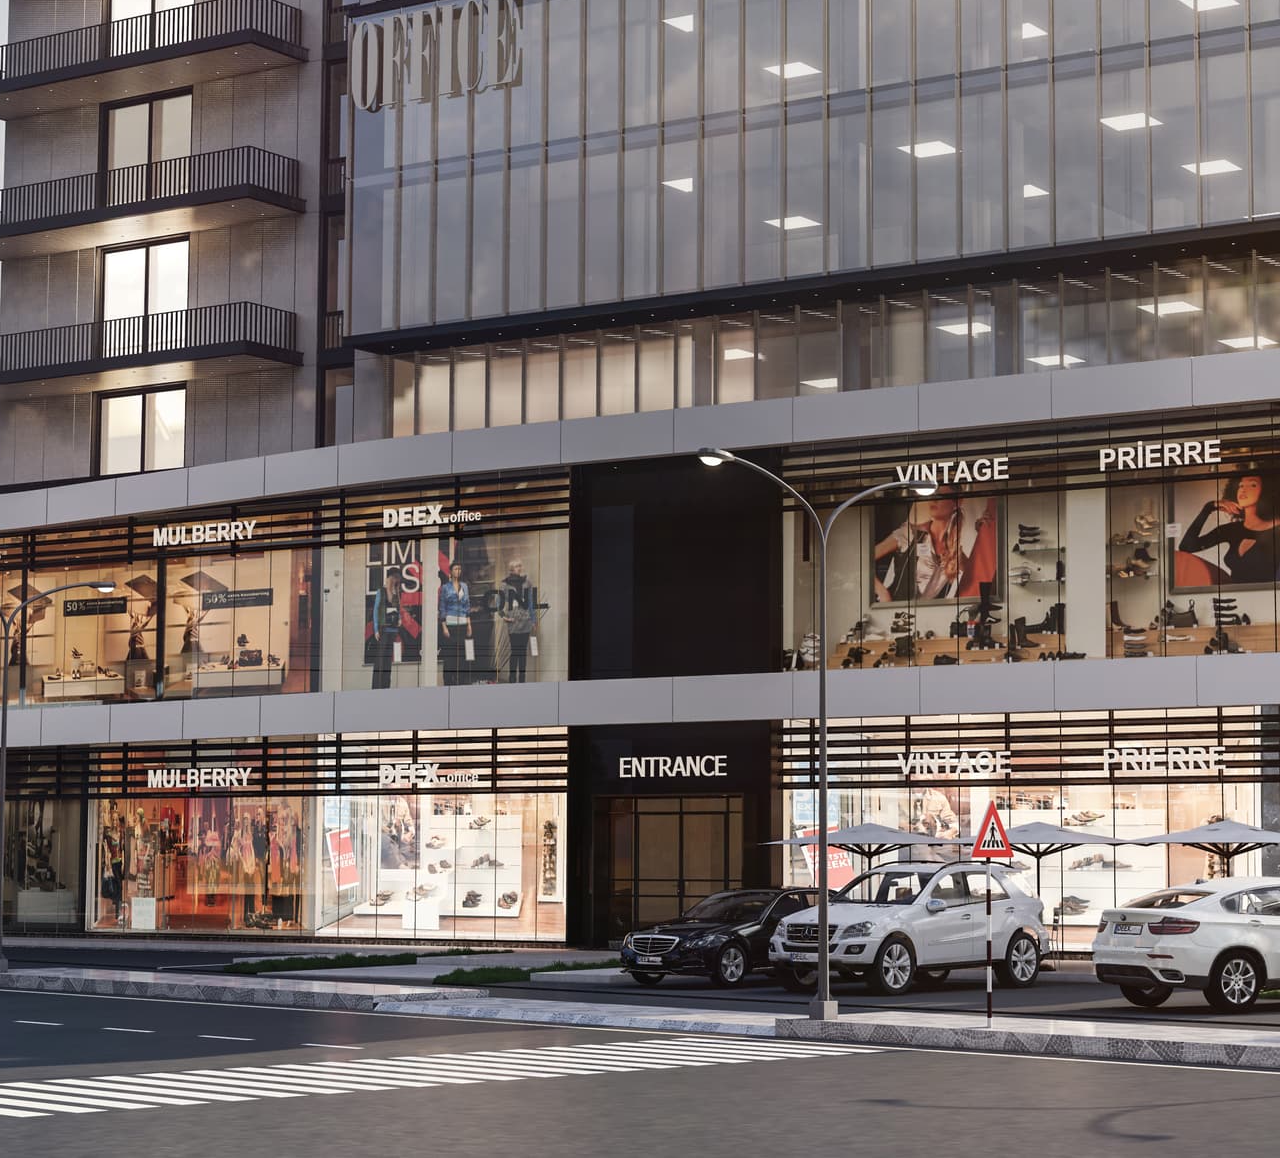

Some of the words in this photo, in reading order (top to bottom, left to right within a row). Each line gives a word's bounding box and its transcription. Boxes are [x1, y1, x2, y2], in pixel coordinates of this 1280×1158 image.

[896, 457, 1009, 484] VINTAGE
[152, 520, 257, 547] MULBERRY
[619, 755, 728, 778] ENTRANCE
[896, 750, 1012, 776] VINTAGE
[147, 768, 253, 788] MULBERRY
